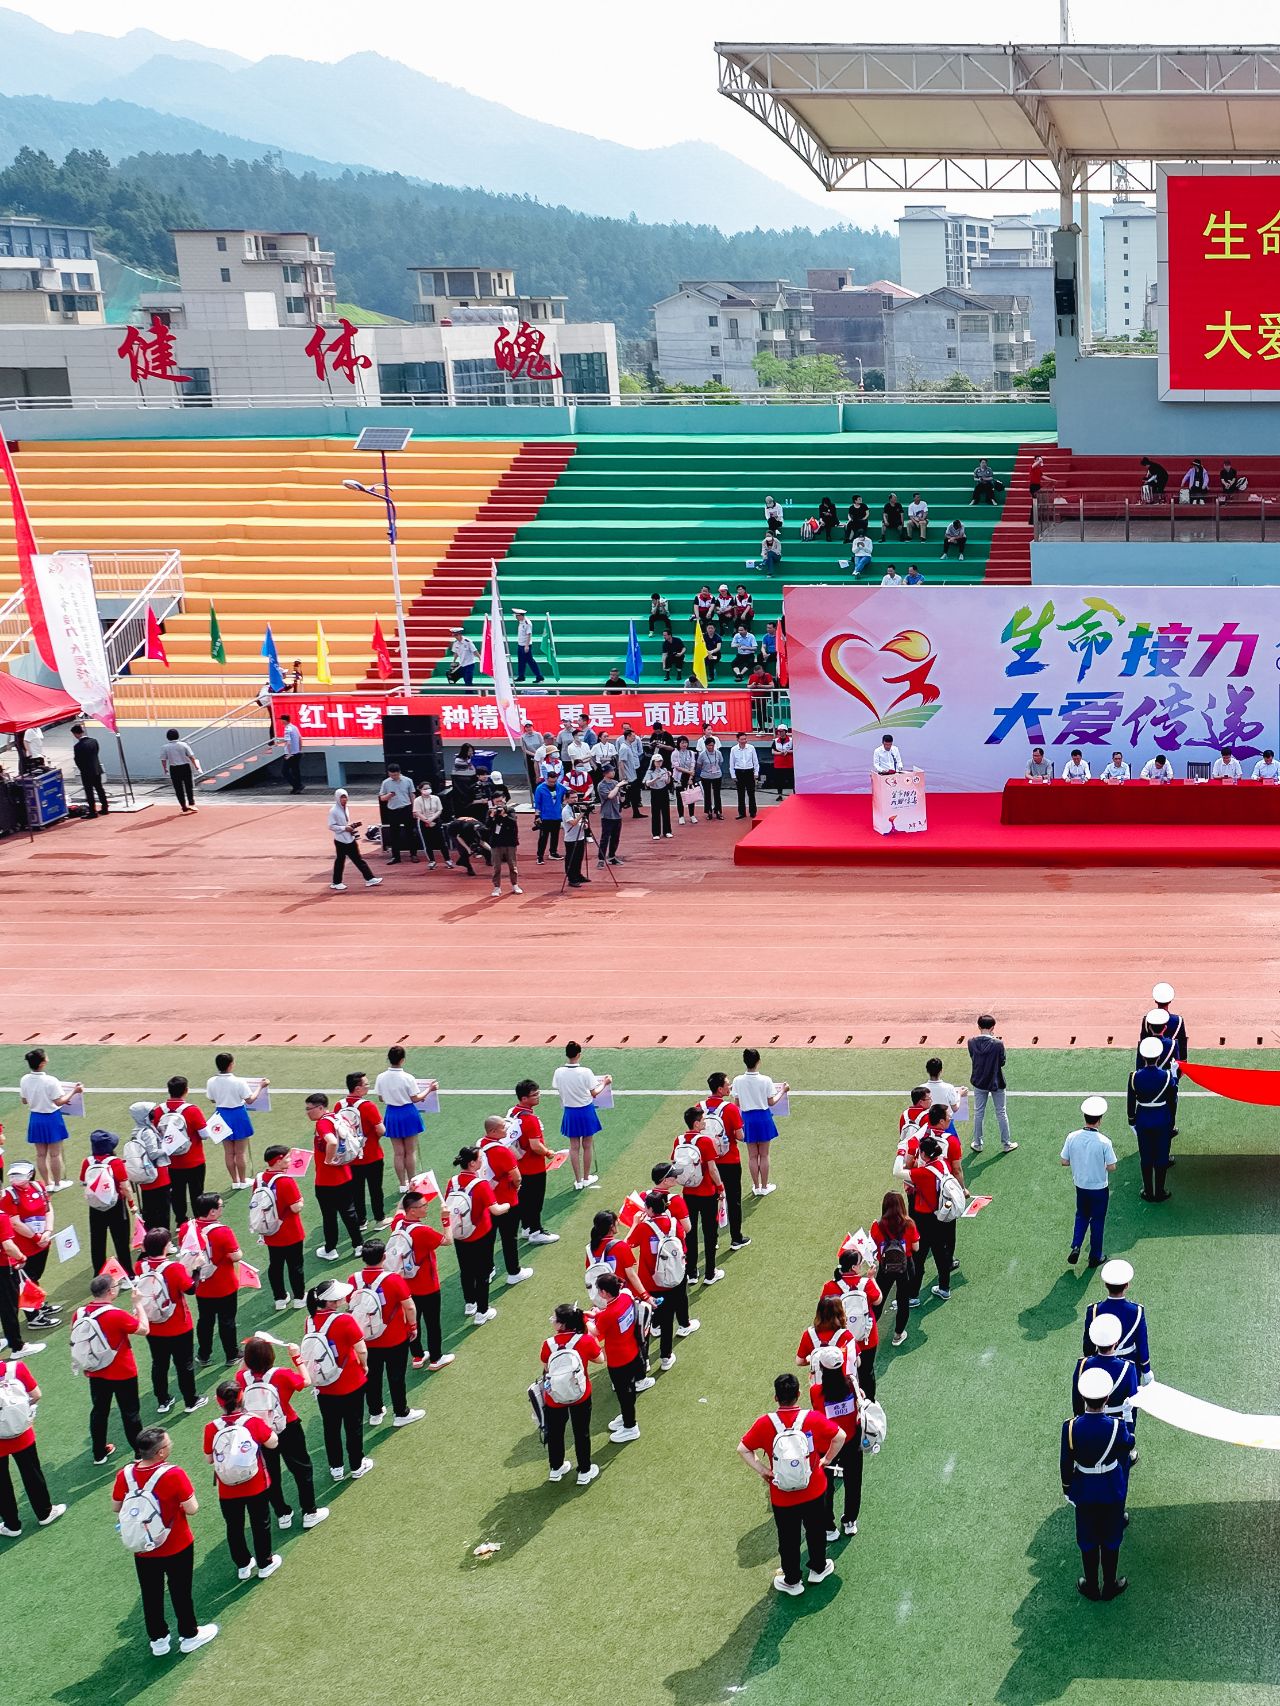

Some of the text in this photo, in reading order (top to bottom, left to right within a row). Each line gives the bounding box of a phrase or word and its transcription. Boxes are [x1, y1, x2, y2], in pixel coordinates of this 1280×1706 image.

[1000, 596, 1260, 684] 生命接力
[557, 700, 728, 729] 更是一面旗帜
[984, 682, 1268, 761] 大爱传递
